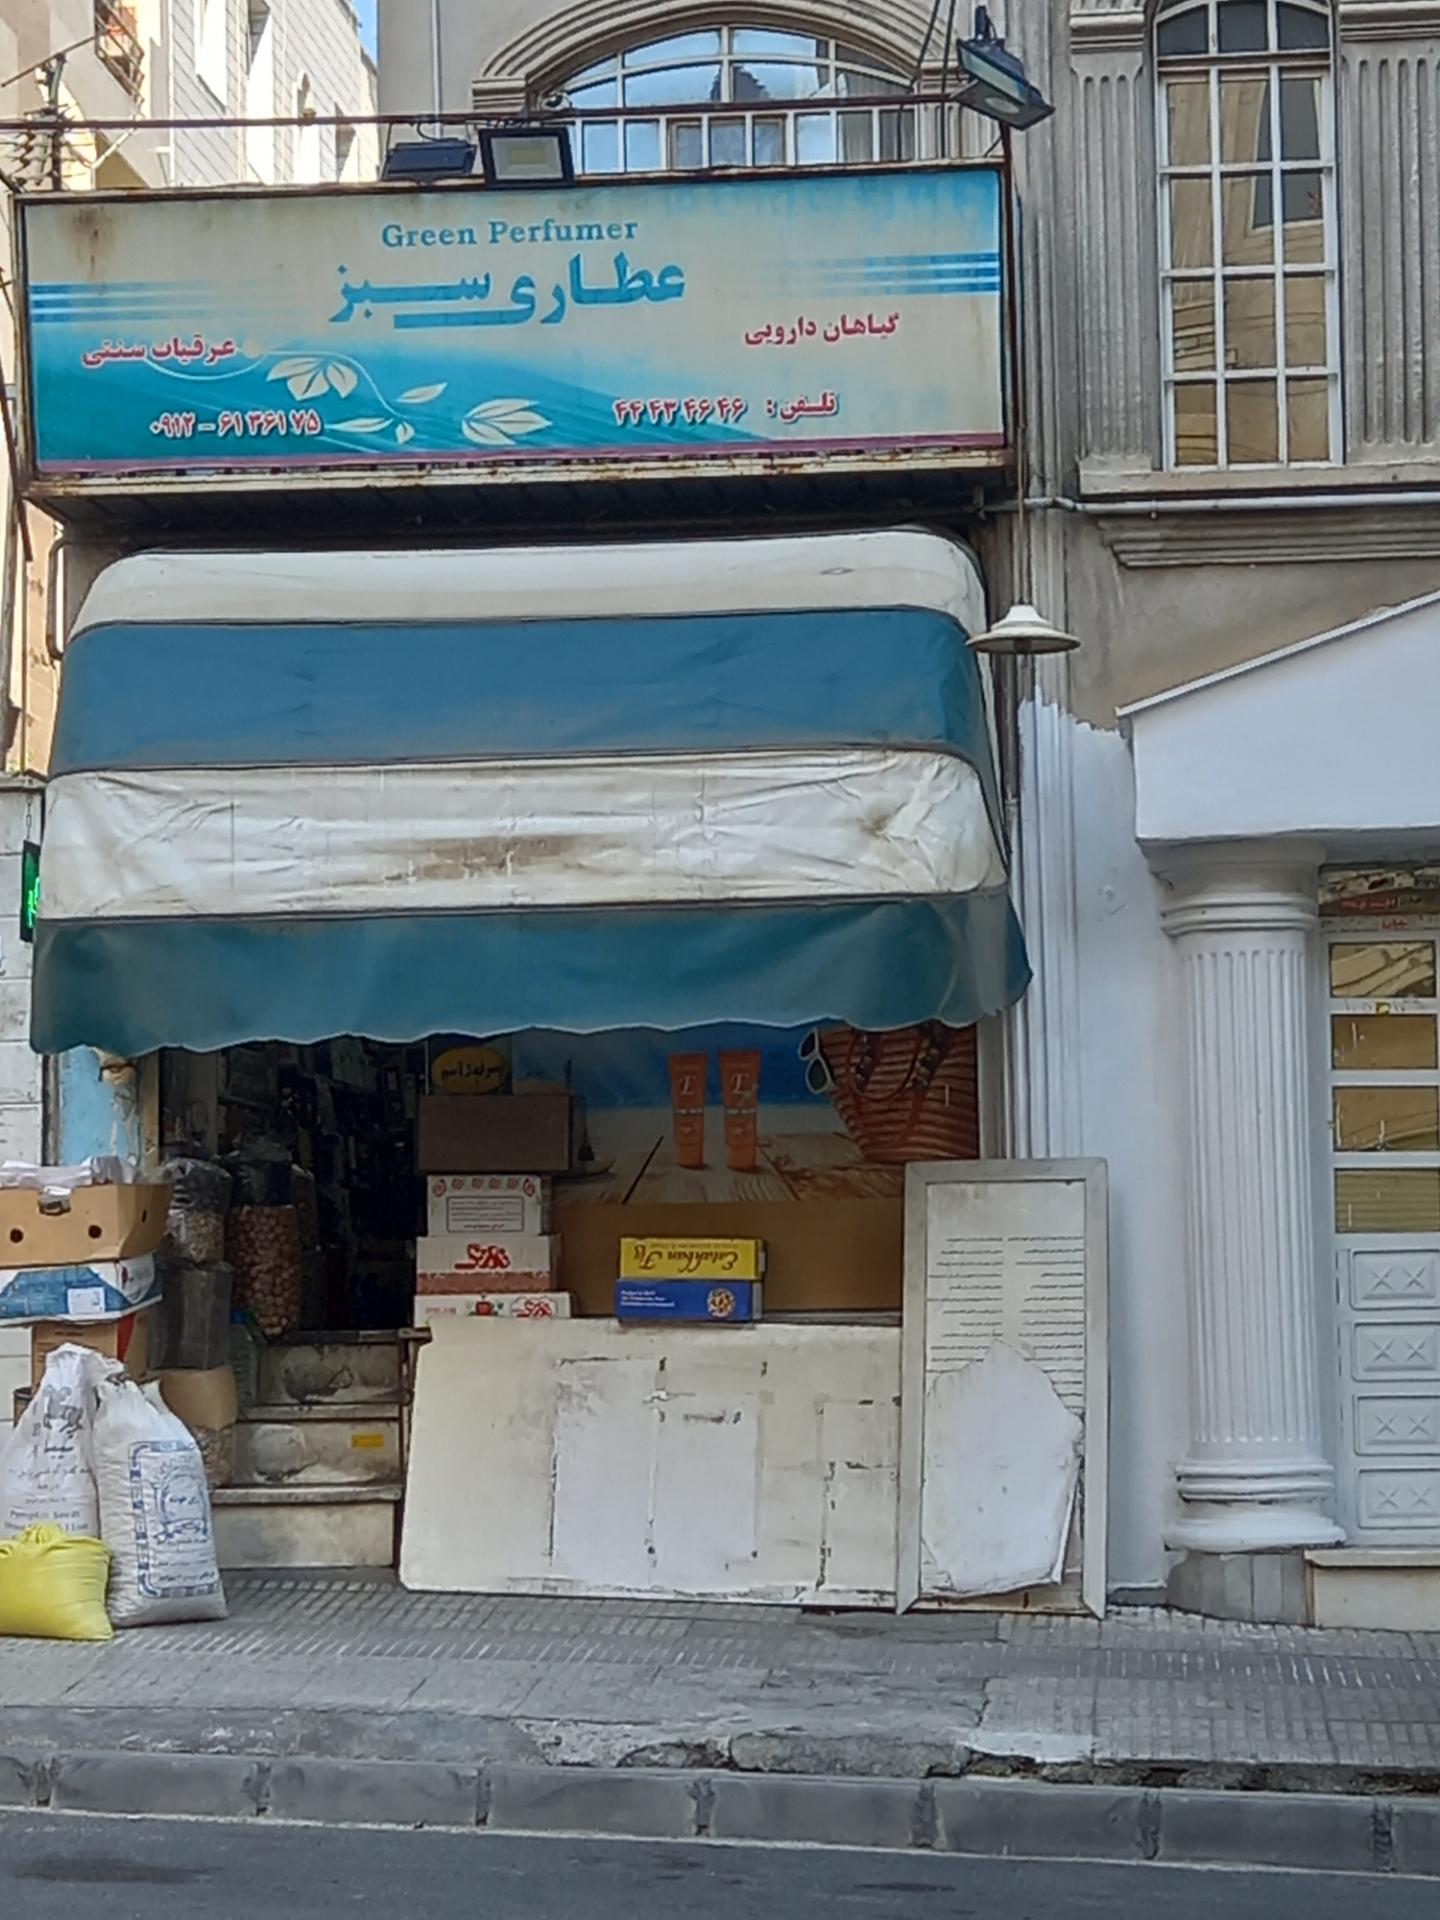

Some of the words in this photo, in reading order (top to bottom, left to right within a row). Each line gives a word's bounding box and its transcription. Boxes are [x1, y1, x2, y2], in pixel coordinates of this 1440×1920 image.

[382, 223, 477, 247] Green
[488, 218, 639, 244] Perfumer
[328, 264, 492, 324] سبز
[394, 250, 686, 330] عطاری
[744, 315, 817, 346] دارویی
[823, 311, 899, 342] گیاهان
[82, 340, 146, 367] سنتی
[152, 335, 235, 364] عرقیات
